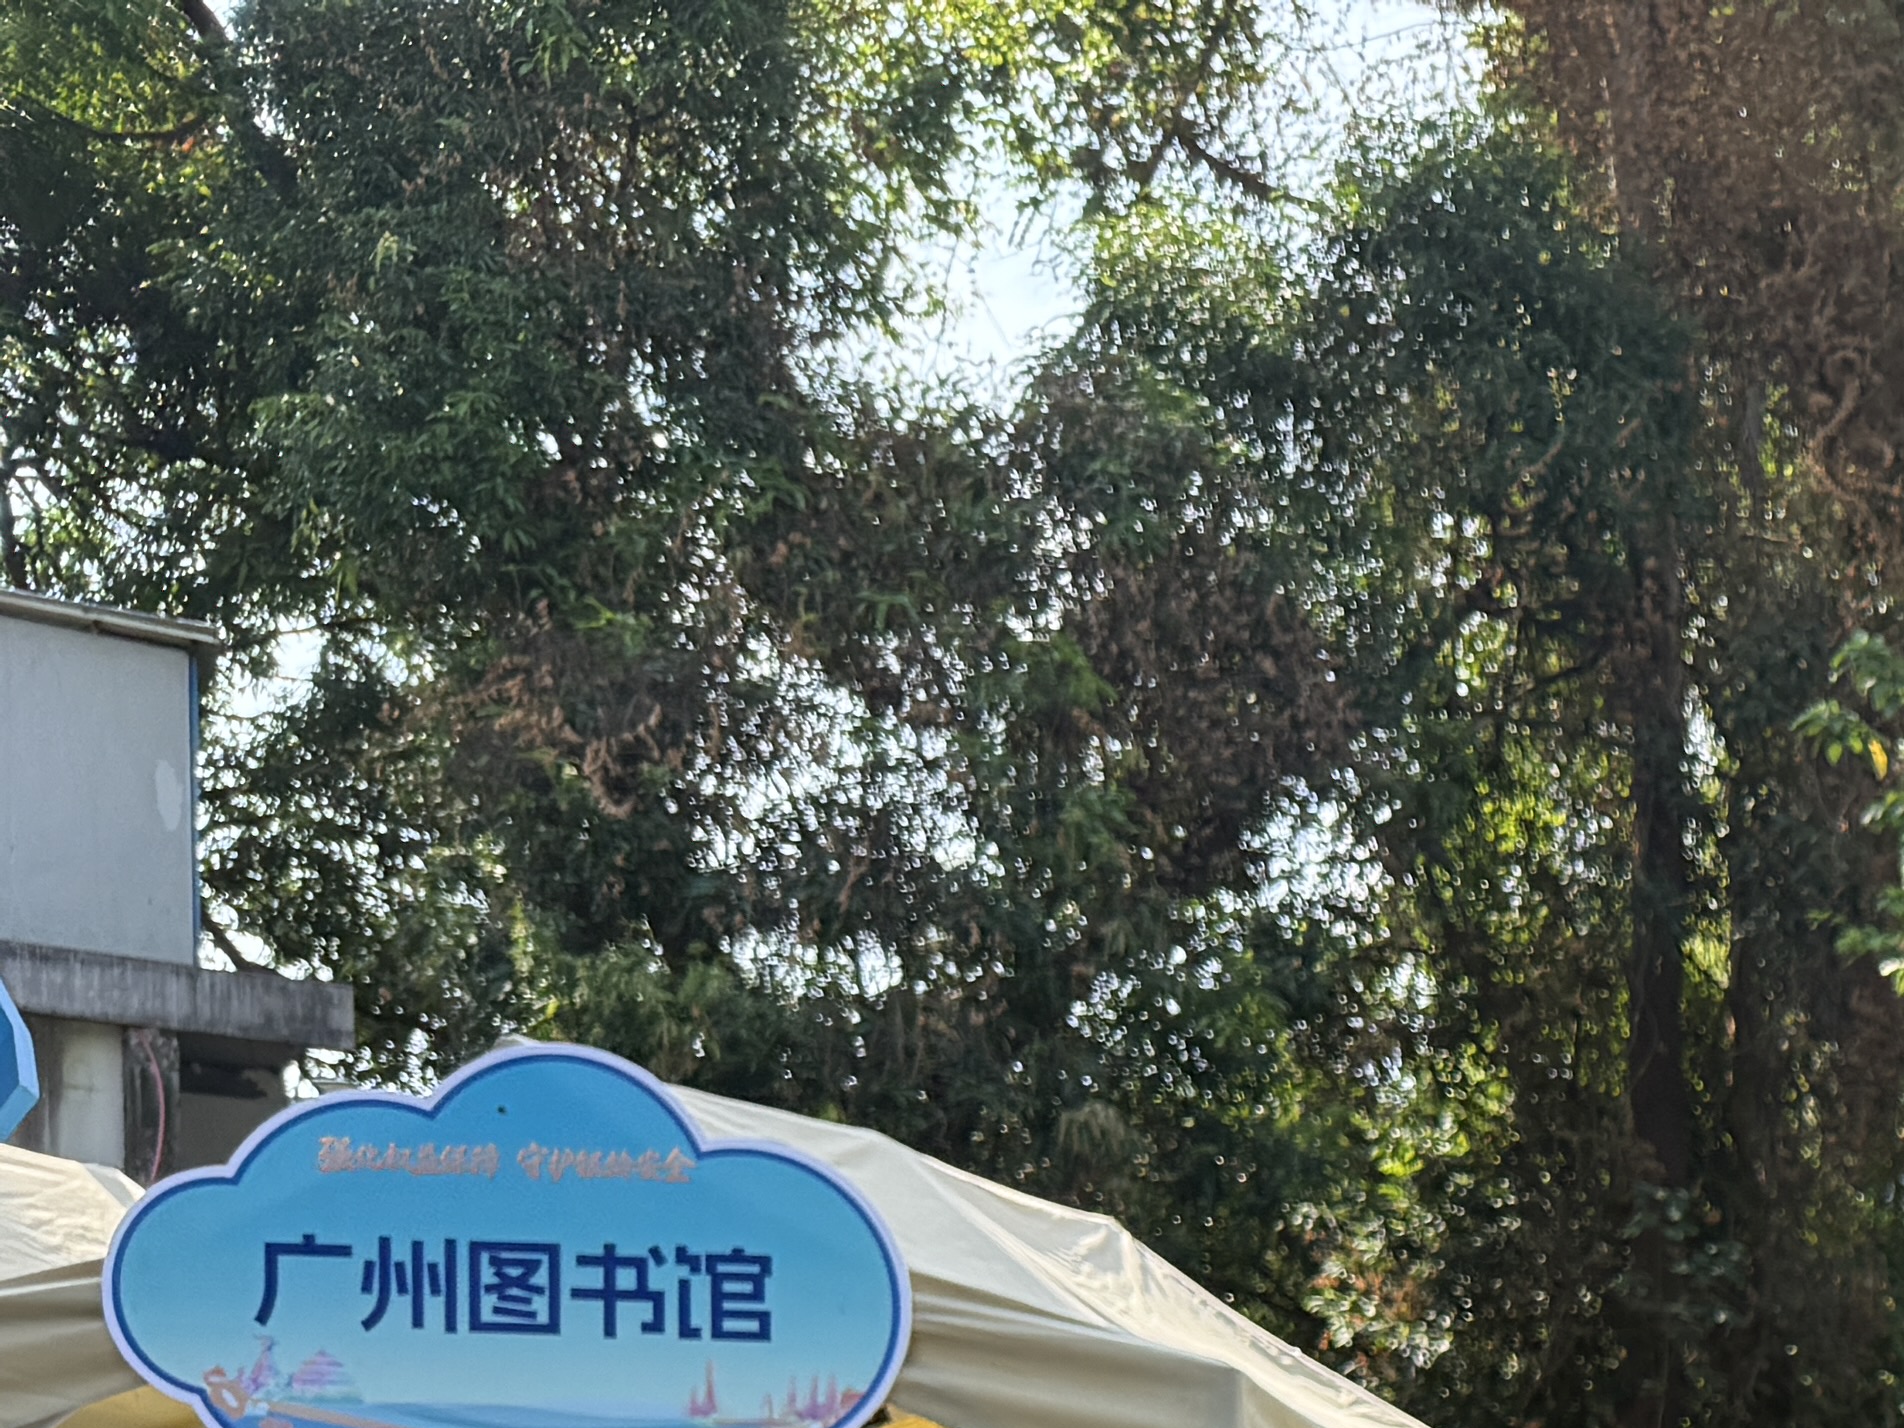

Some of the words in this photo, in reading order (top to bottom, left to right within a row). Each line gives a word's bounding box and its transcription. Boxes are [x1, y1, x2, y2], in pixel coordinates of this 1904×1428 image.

[252, 1233, 774, 1343] 广州图书馆
